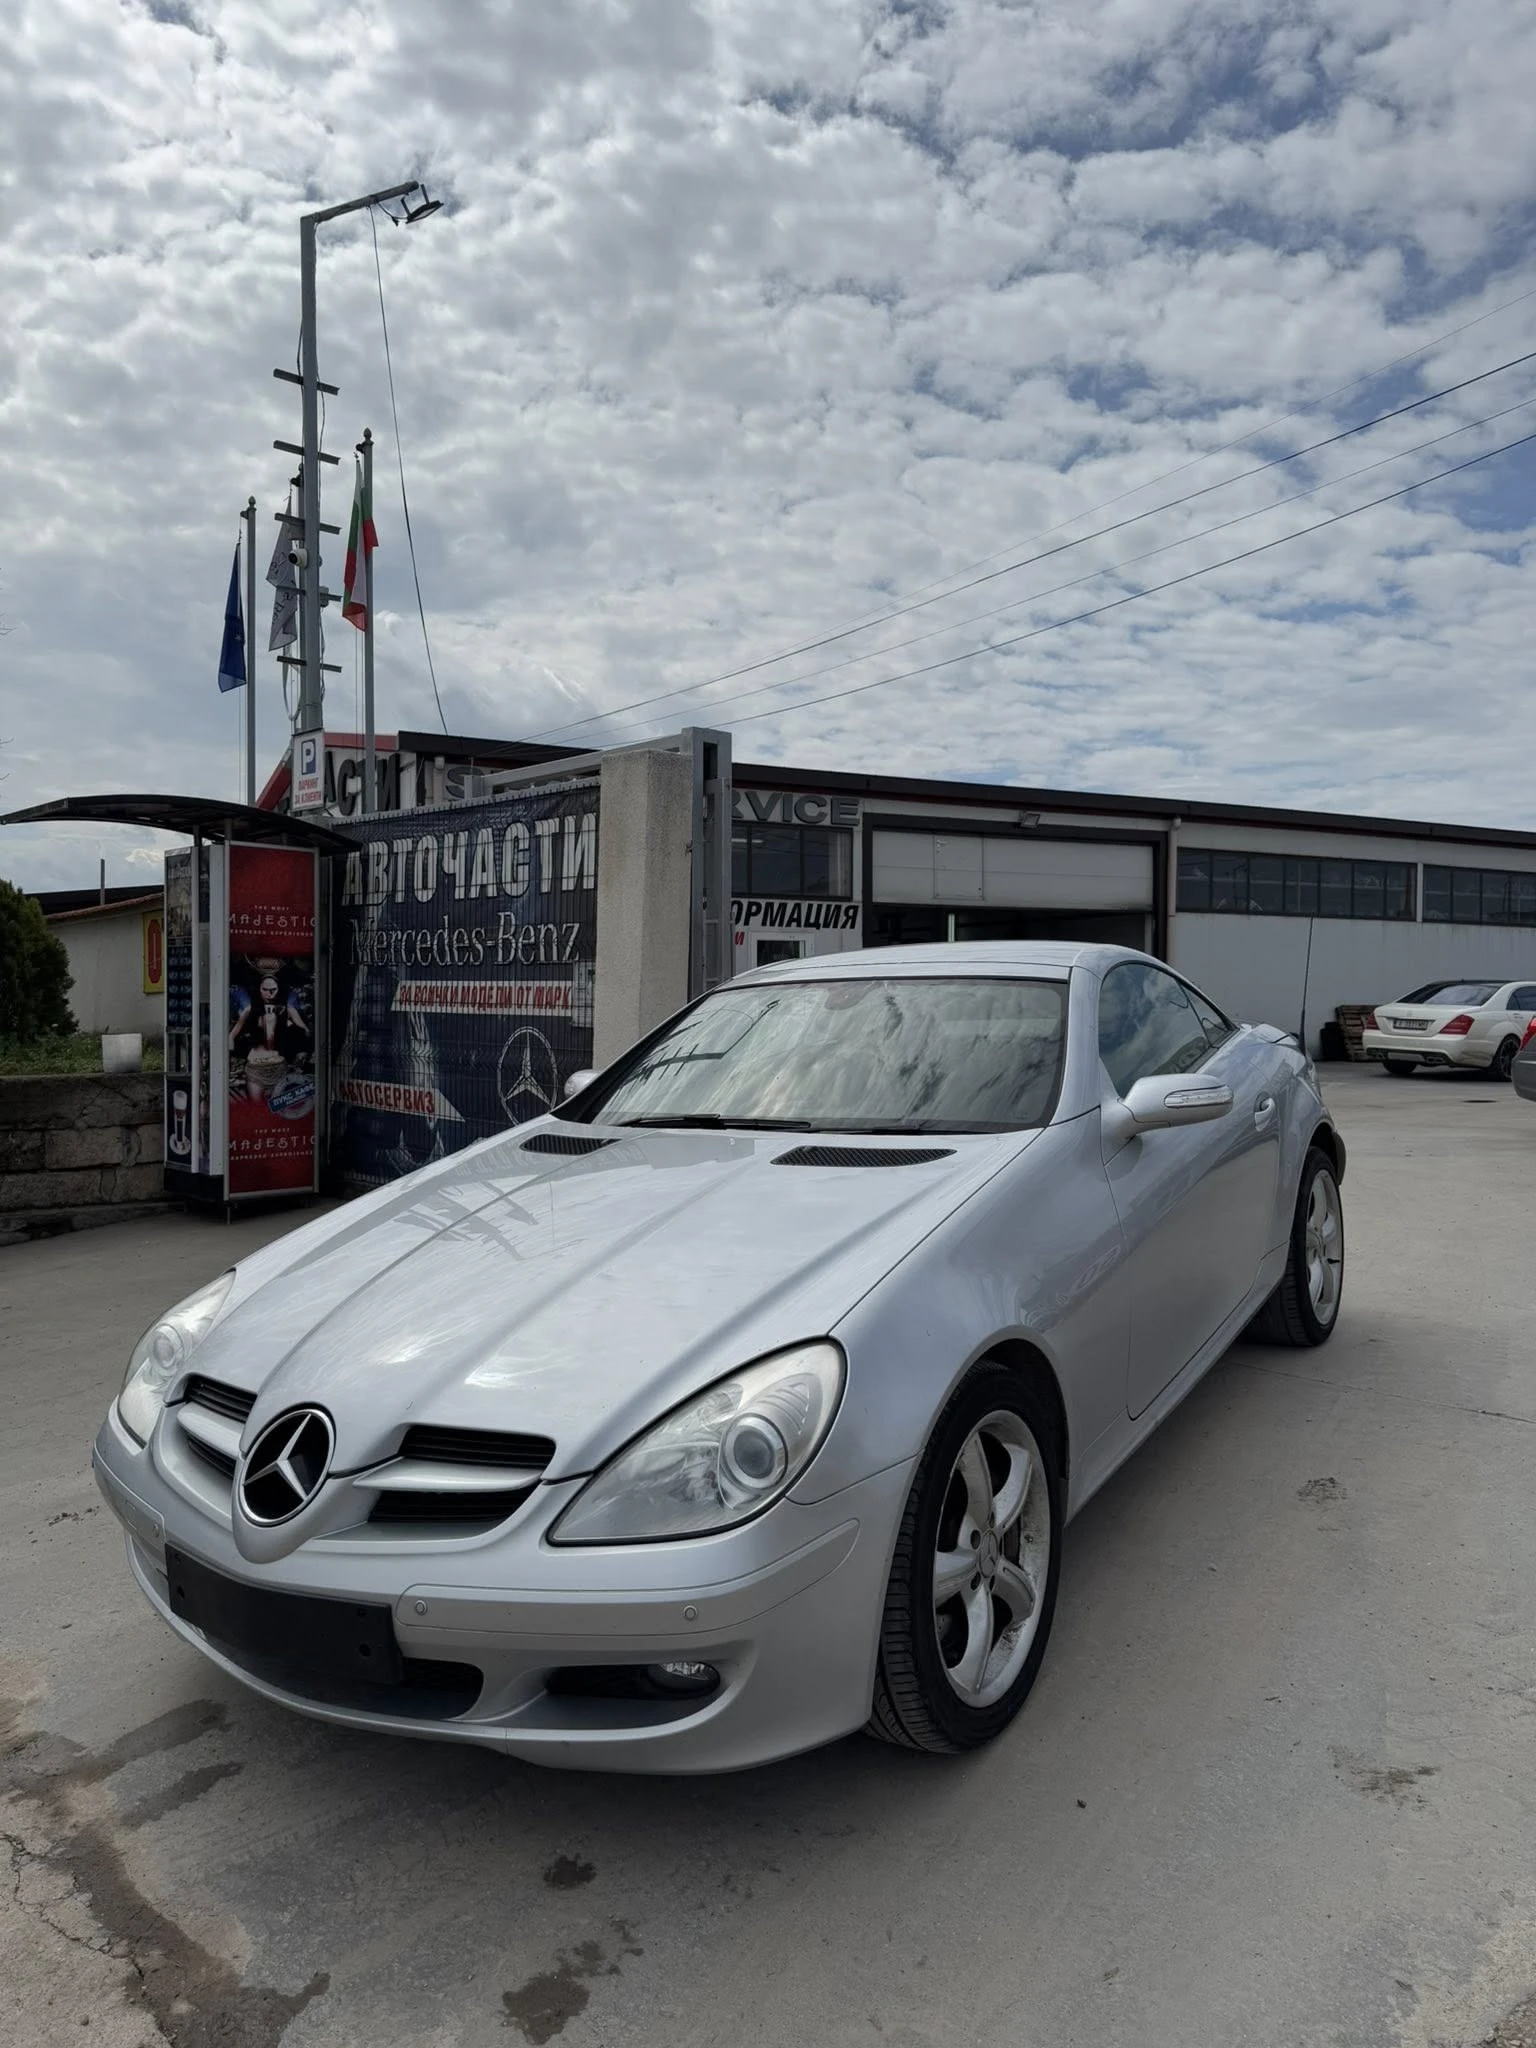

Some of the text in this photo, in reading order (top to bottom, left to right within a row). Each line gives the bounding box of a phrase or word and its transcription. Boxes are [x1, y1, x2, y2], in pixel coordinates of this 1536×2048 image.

[302, 740, 315, 774] P
[341, 812, 597, 907] АВТОЧАСТИ
[229, 913, 319, 928] MAJESTIC
[350, 911, 580, 967] Mercedes-Benz
[400, 985, 413, 1006] ЗА
[460, 985, 513, 1011] МОДЕЛИ
[517, 986, 531, 1009] ОТ
[339, 1080, 435, 1114] АВТОСЕРВИЗ
